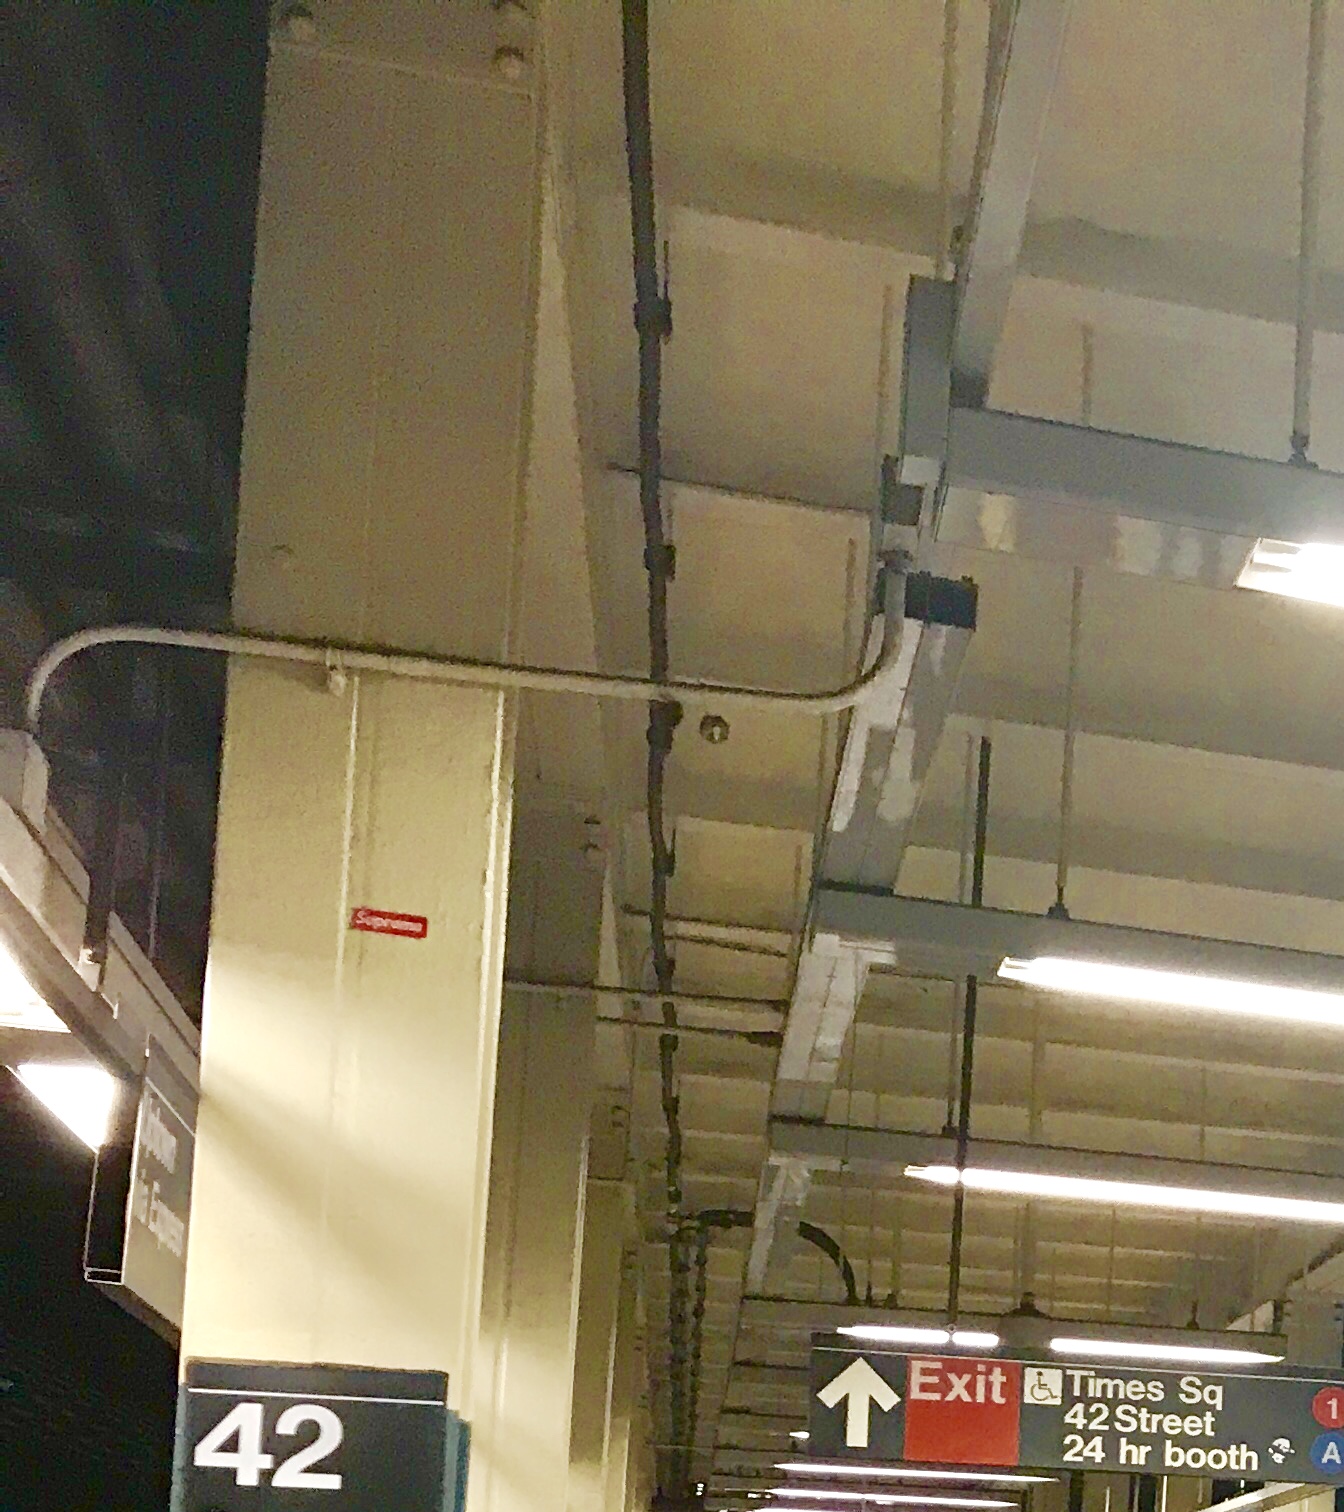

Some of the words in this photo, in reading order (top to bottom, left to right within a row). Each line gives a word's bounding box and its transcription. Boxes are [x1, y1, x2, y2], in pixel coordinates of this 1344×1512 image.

[910, 1361, 1007, 1404] Exit
[1065, 1369, 1165, 1401] Times
[1179, 1376, 1223, 1410] Sq
[1063, 1402, 1109, 1431] 42
[1113, 1408, 1216, 1436] Street
[193, 1402, 344, 1489] 42
[1062, 1435, 1106, 1463] 24
[1119, 1438, 1152, 1466] hr
[1164, 1440, 1259, 1471] booth
